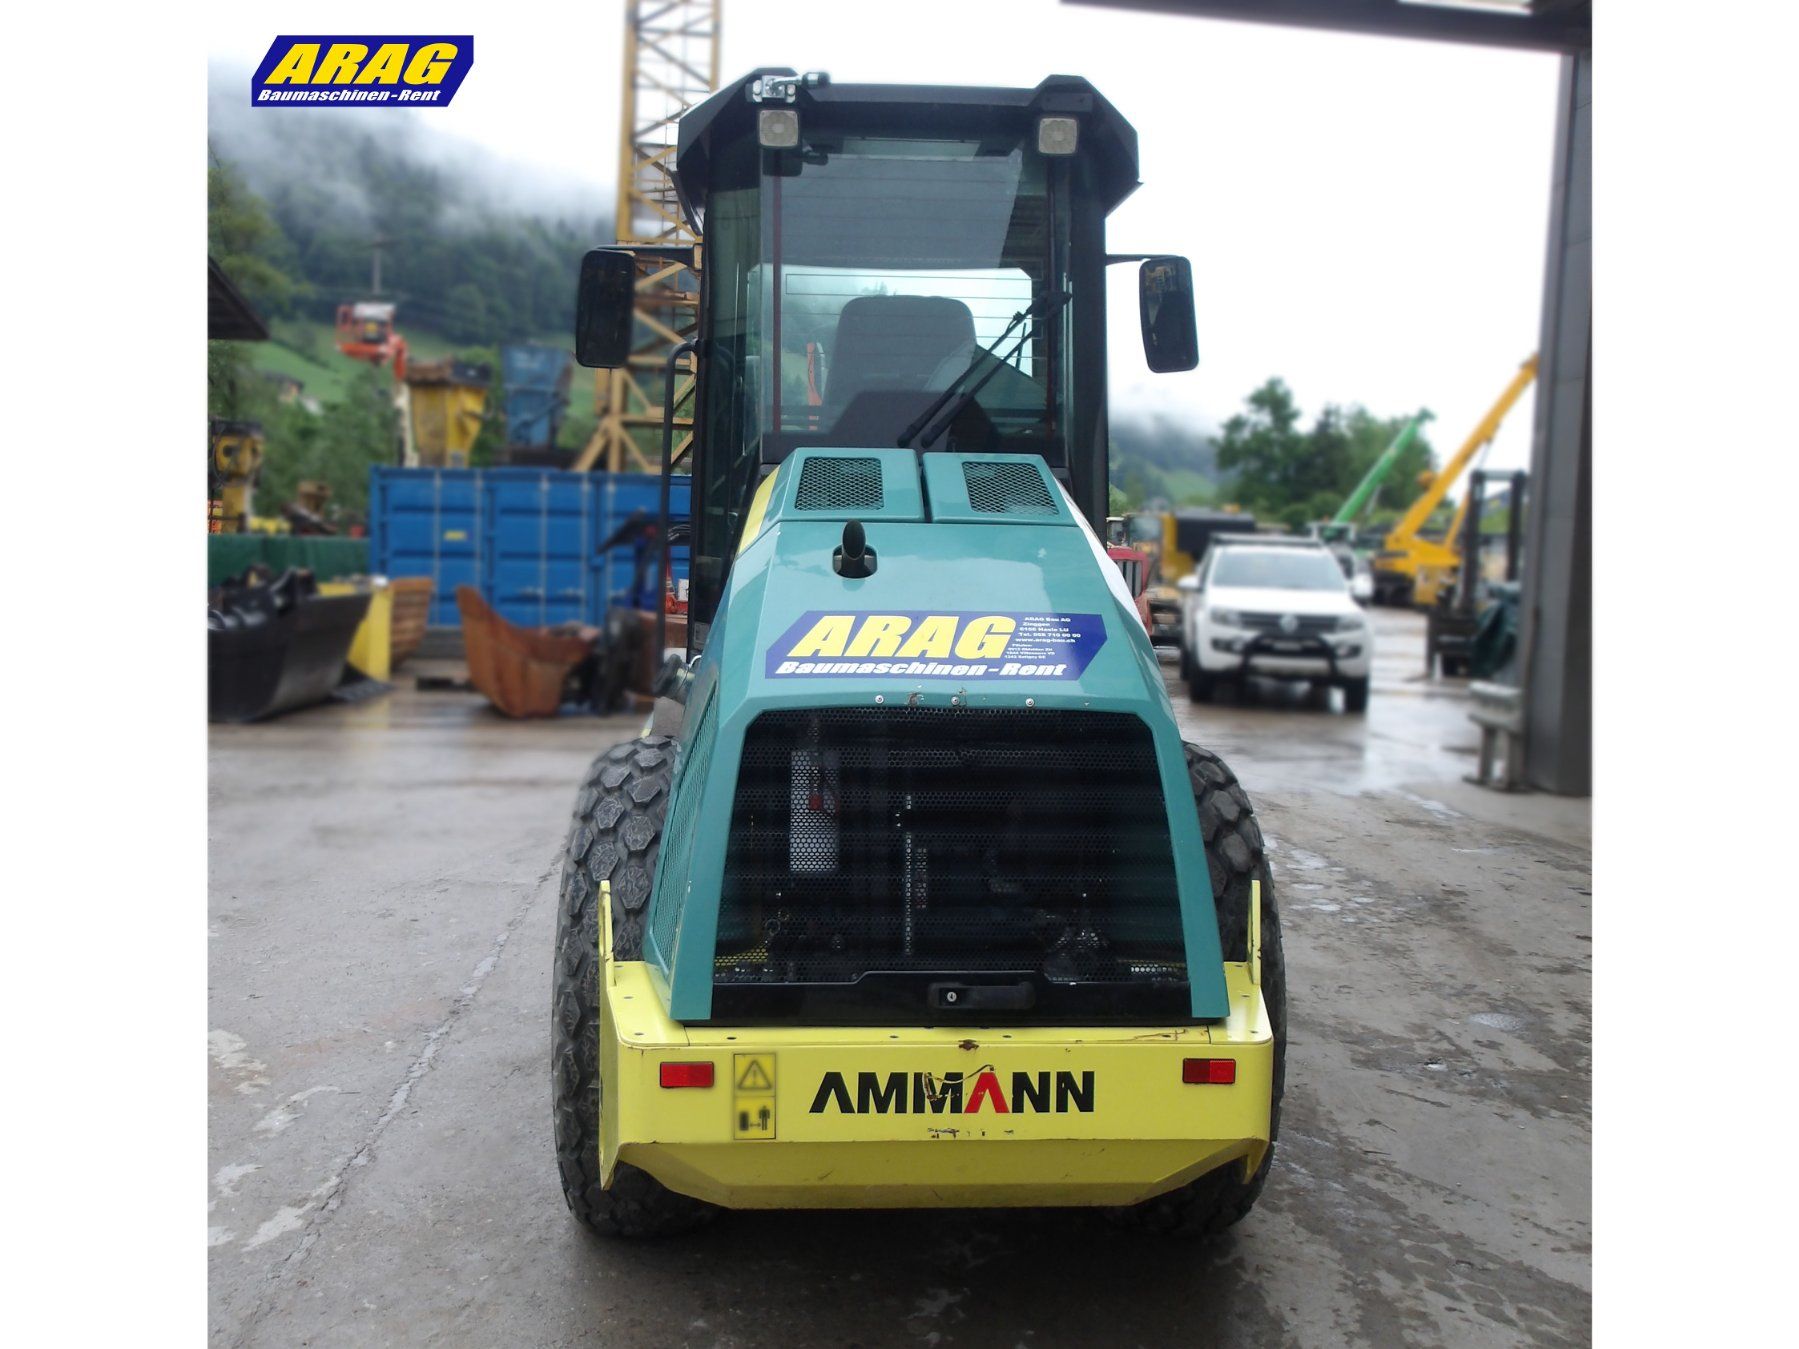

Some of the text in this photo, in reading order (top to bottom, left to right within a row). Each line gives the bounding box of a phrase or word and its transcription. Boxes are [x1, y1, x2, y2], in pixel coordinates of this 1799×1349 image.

[786, 615, 1017, 659] ARAG
[775, 660, 1068, 677] Baumaschinen-Rent
[808, 1071, 1096, 1114] AMMANN
